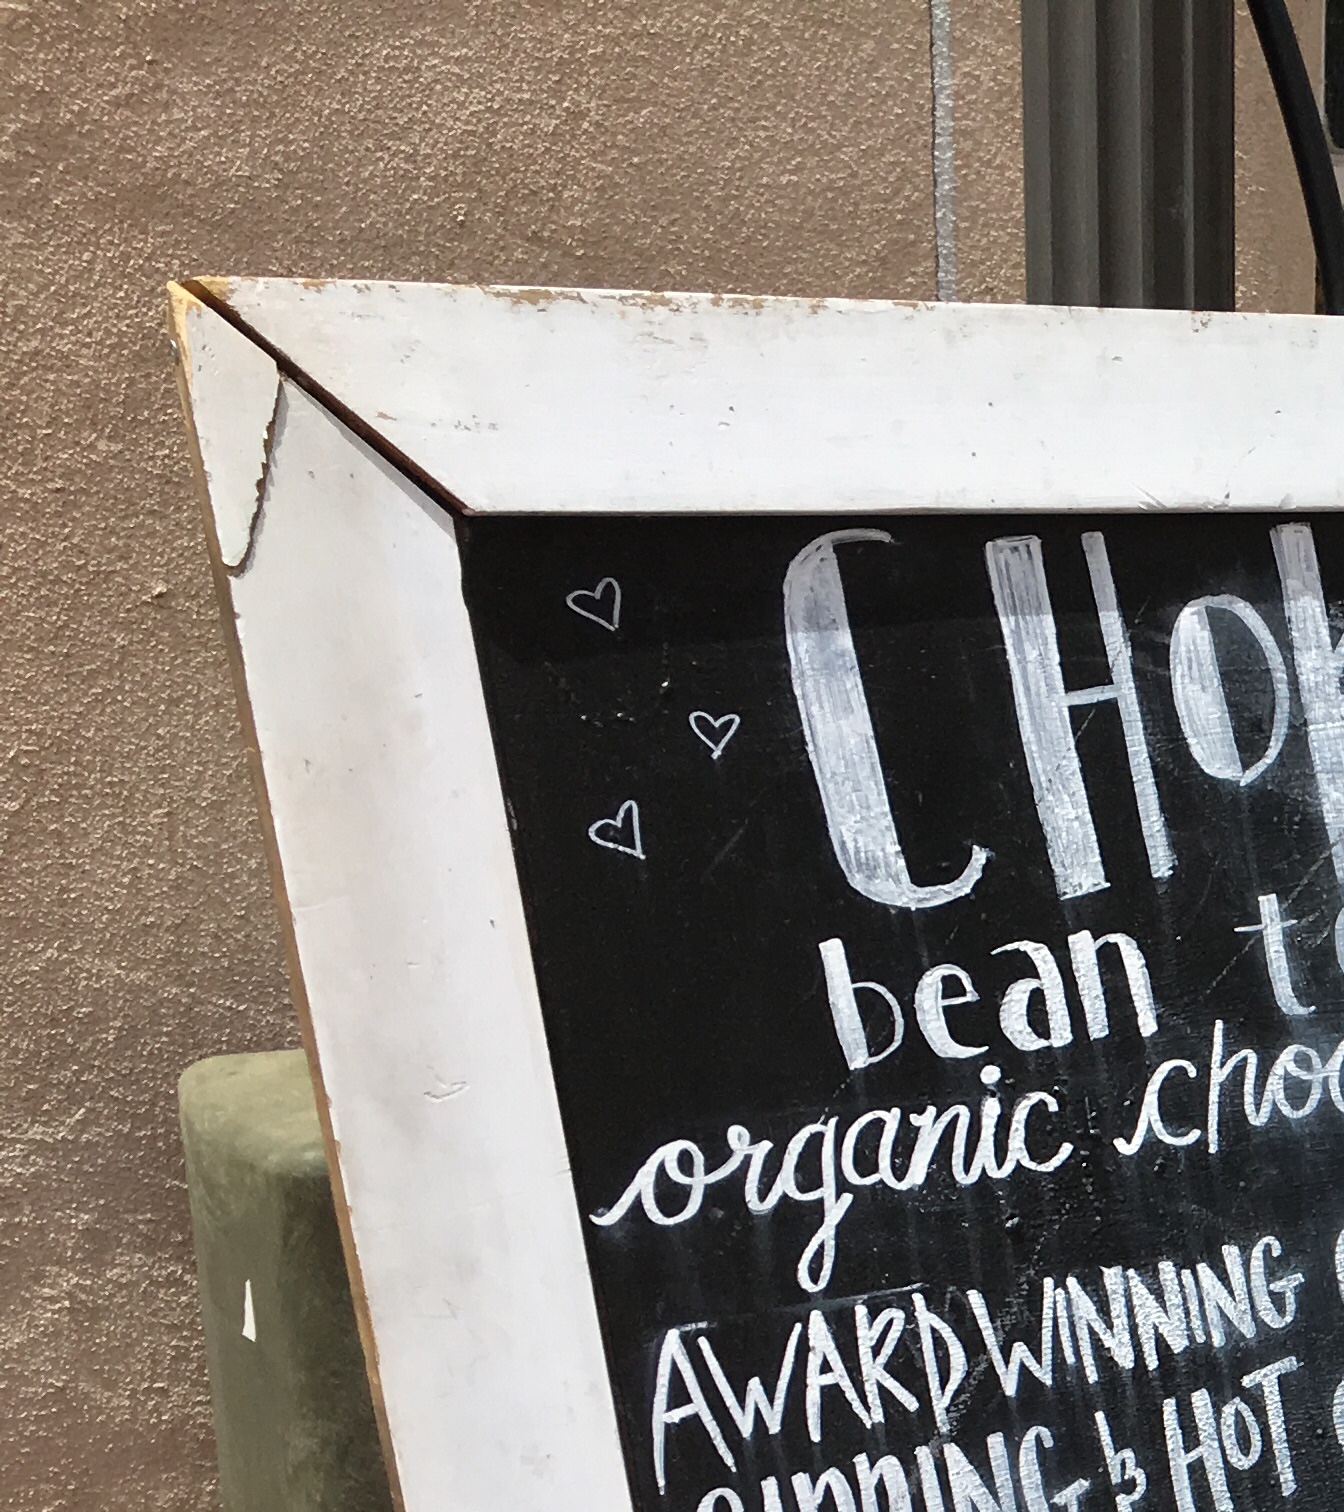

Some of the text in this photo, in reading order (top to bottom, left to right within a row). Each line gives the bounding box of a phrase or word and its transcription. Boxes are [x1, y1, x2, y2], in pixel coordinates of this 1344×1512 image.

[818, 929, 1158, 1071] bean
[589, 1064, 1074, 1294] organic
[650, 1290, 968, 1495] AWARD
[966, 1236, 1305, 1398] WINNING
